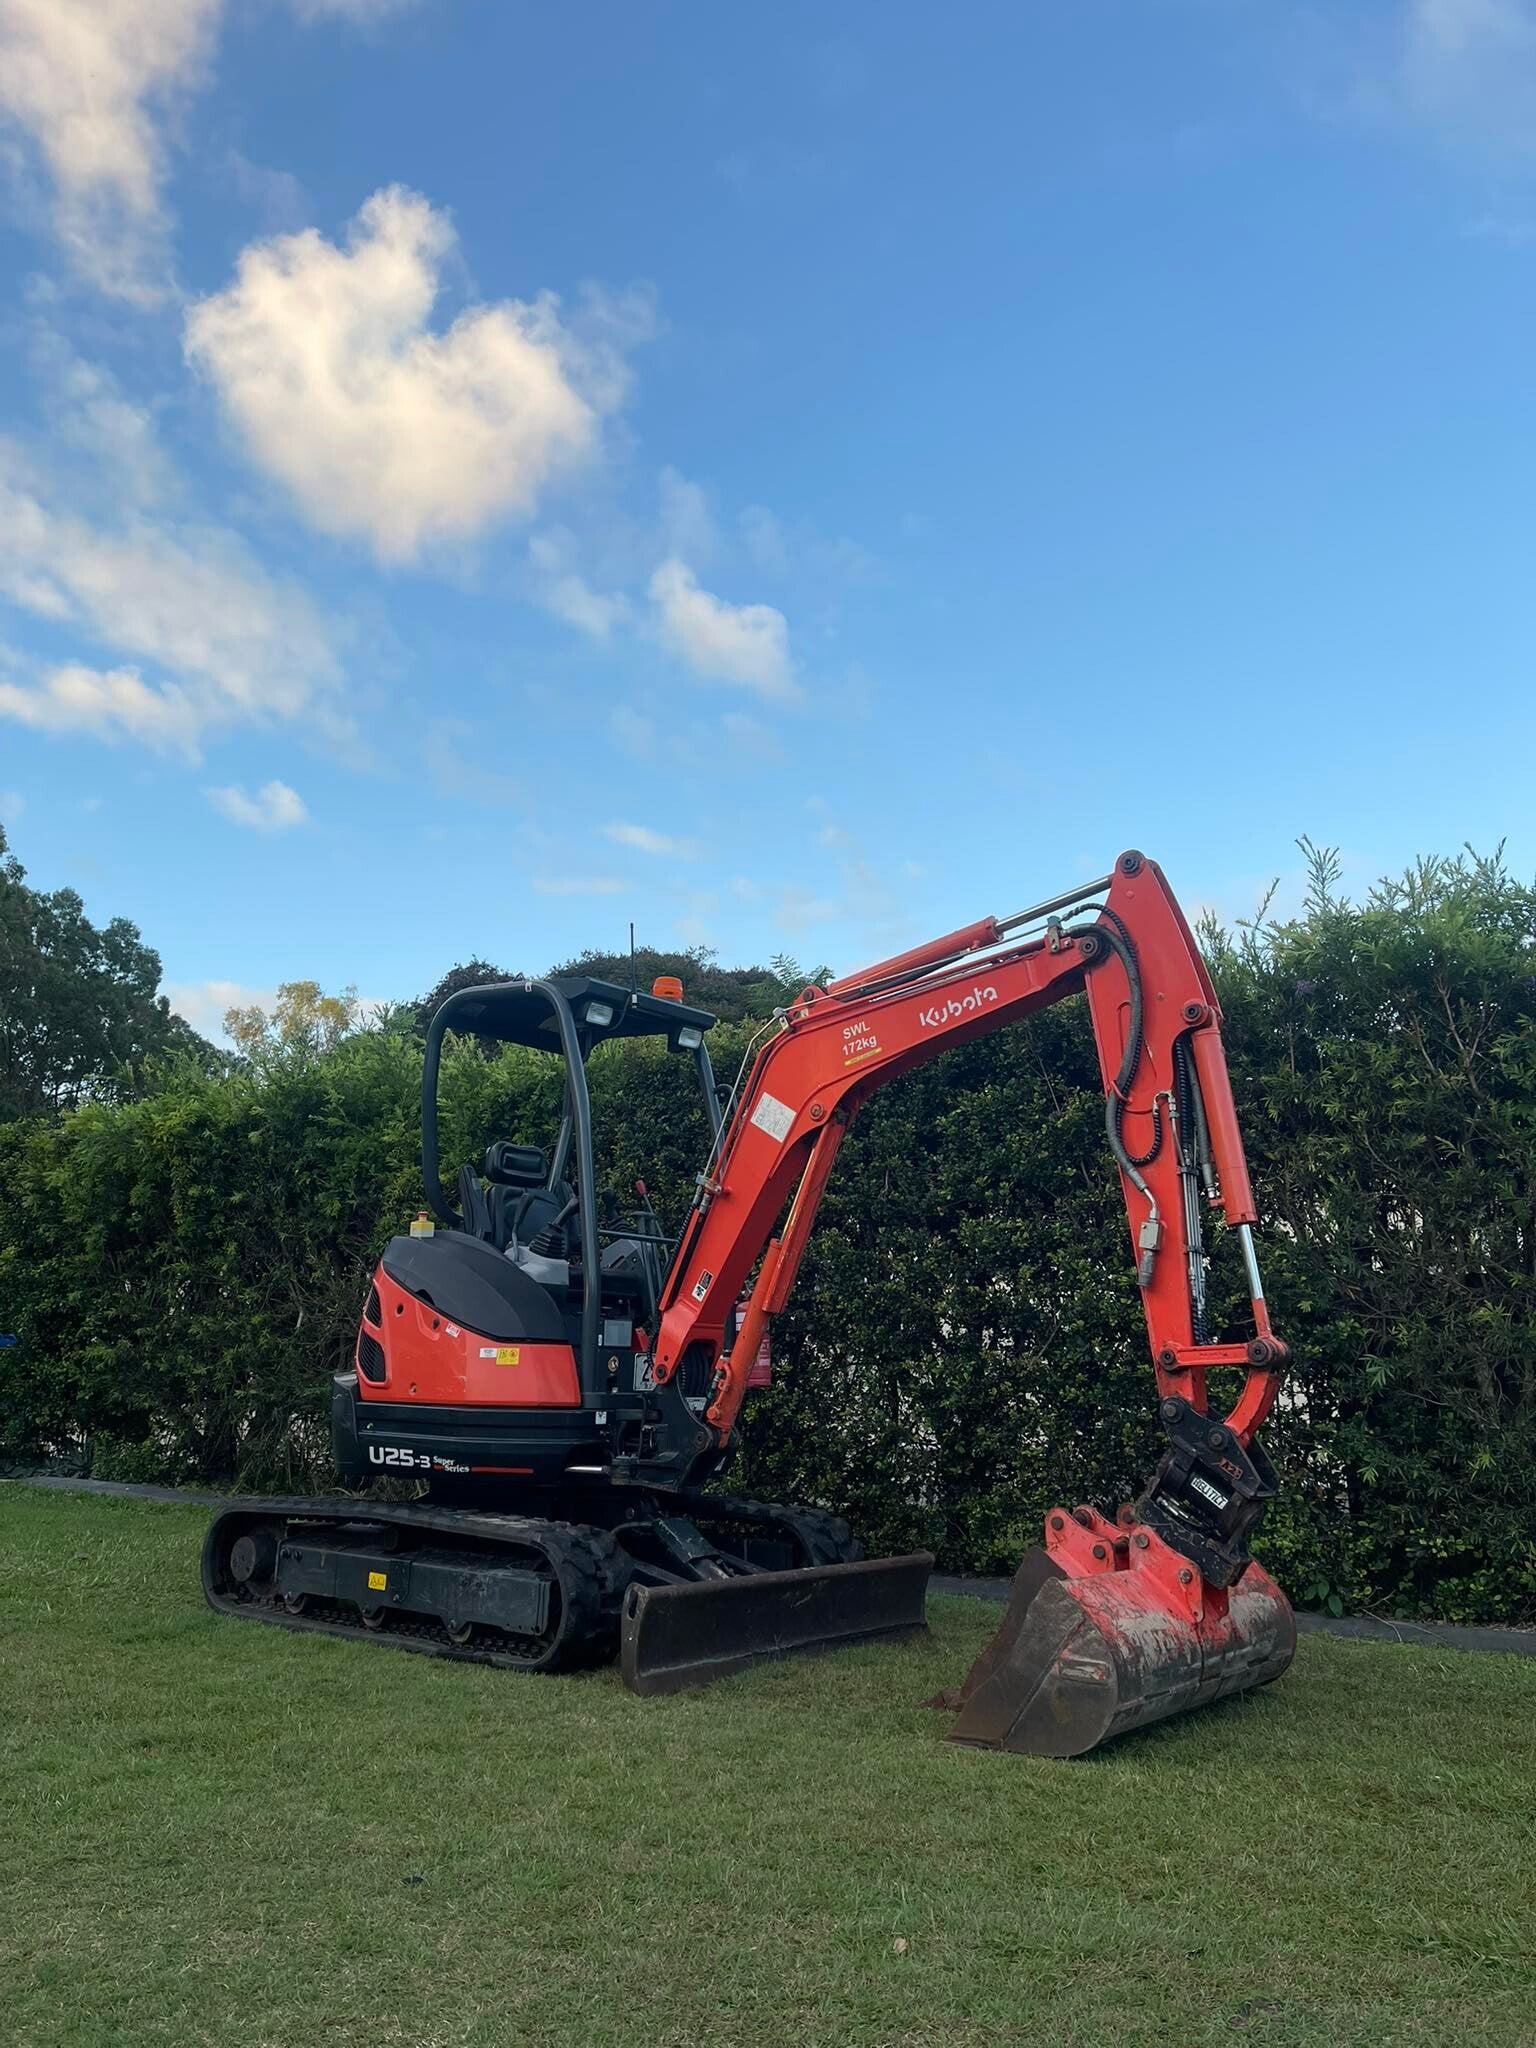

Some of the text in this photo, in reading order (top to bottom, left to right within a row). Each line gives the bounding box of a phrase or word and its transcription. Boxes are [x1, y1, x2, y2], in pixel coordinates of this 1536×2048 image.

[919, 987, 998, 1027] Kubota
[843, 1021, 870, 1039] SWL
[842, 1035, 877, 1056] 172kg
[369, 1446, 431, 1468] U25-3
[433, 1456, 455, 1467] Super
[444, 1464, 470, 1473] Series
